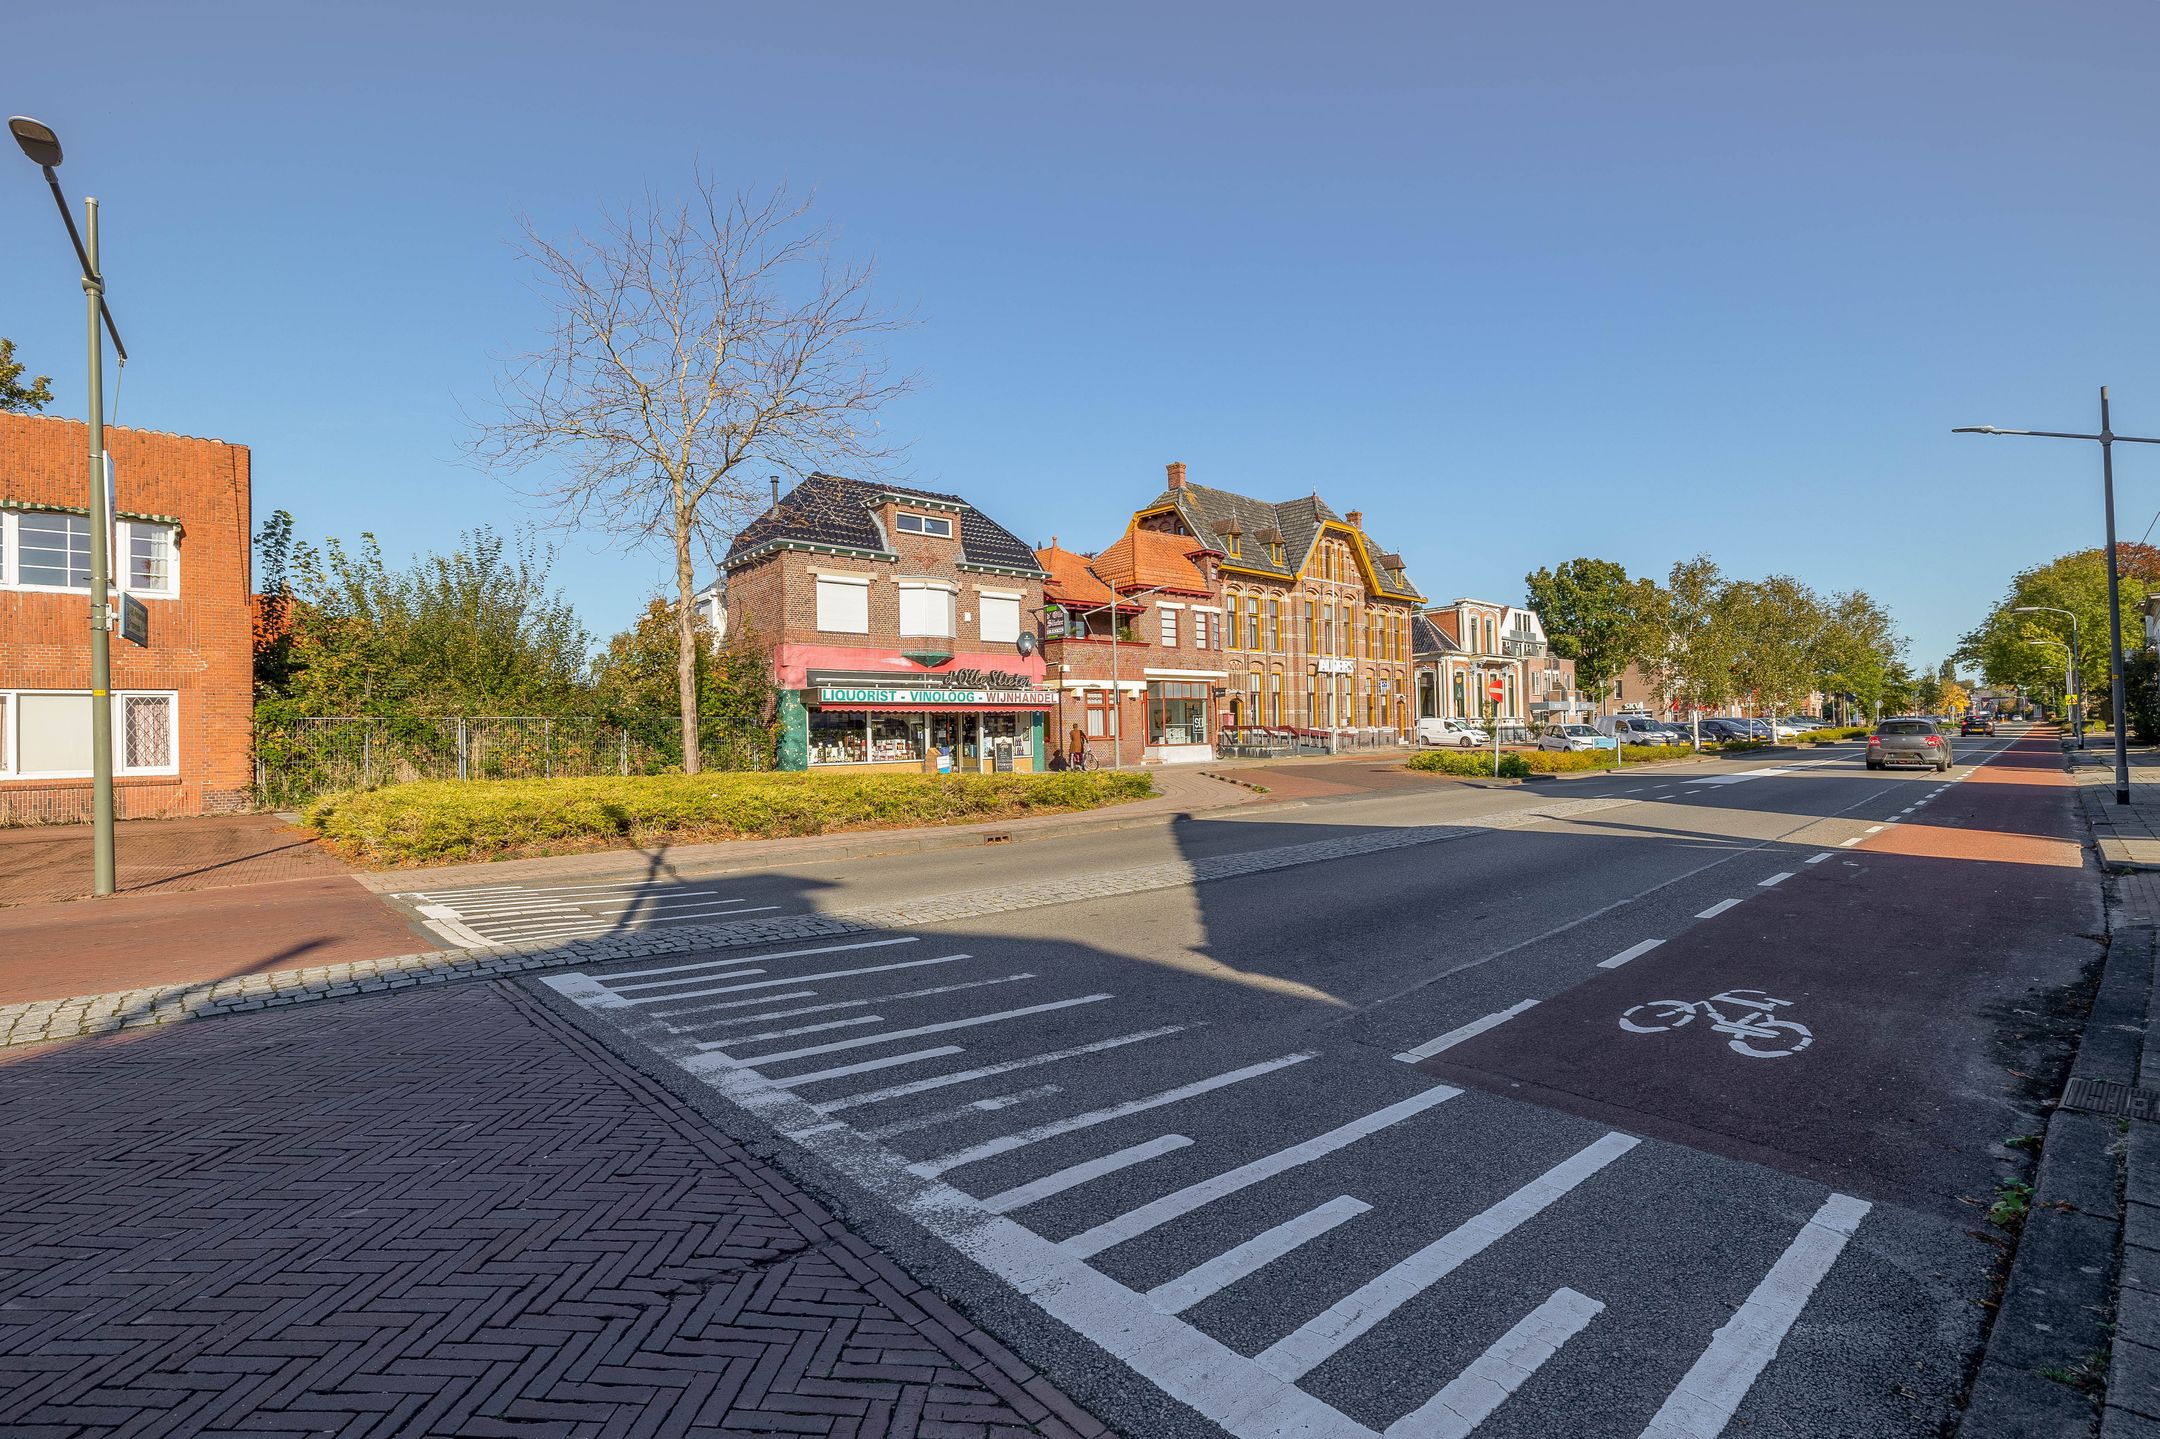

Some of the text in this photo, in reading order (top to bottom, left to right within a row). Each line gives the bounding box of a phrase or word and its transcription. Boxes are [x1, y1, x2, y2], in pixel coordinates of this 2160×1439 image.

[822, 689, 897, 701] LIQUORIST
[911, 691, 974, 702] VINOLOOG
[986, 692, 1057, 703] WIJNHANDEL
